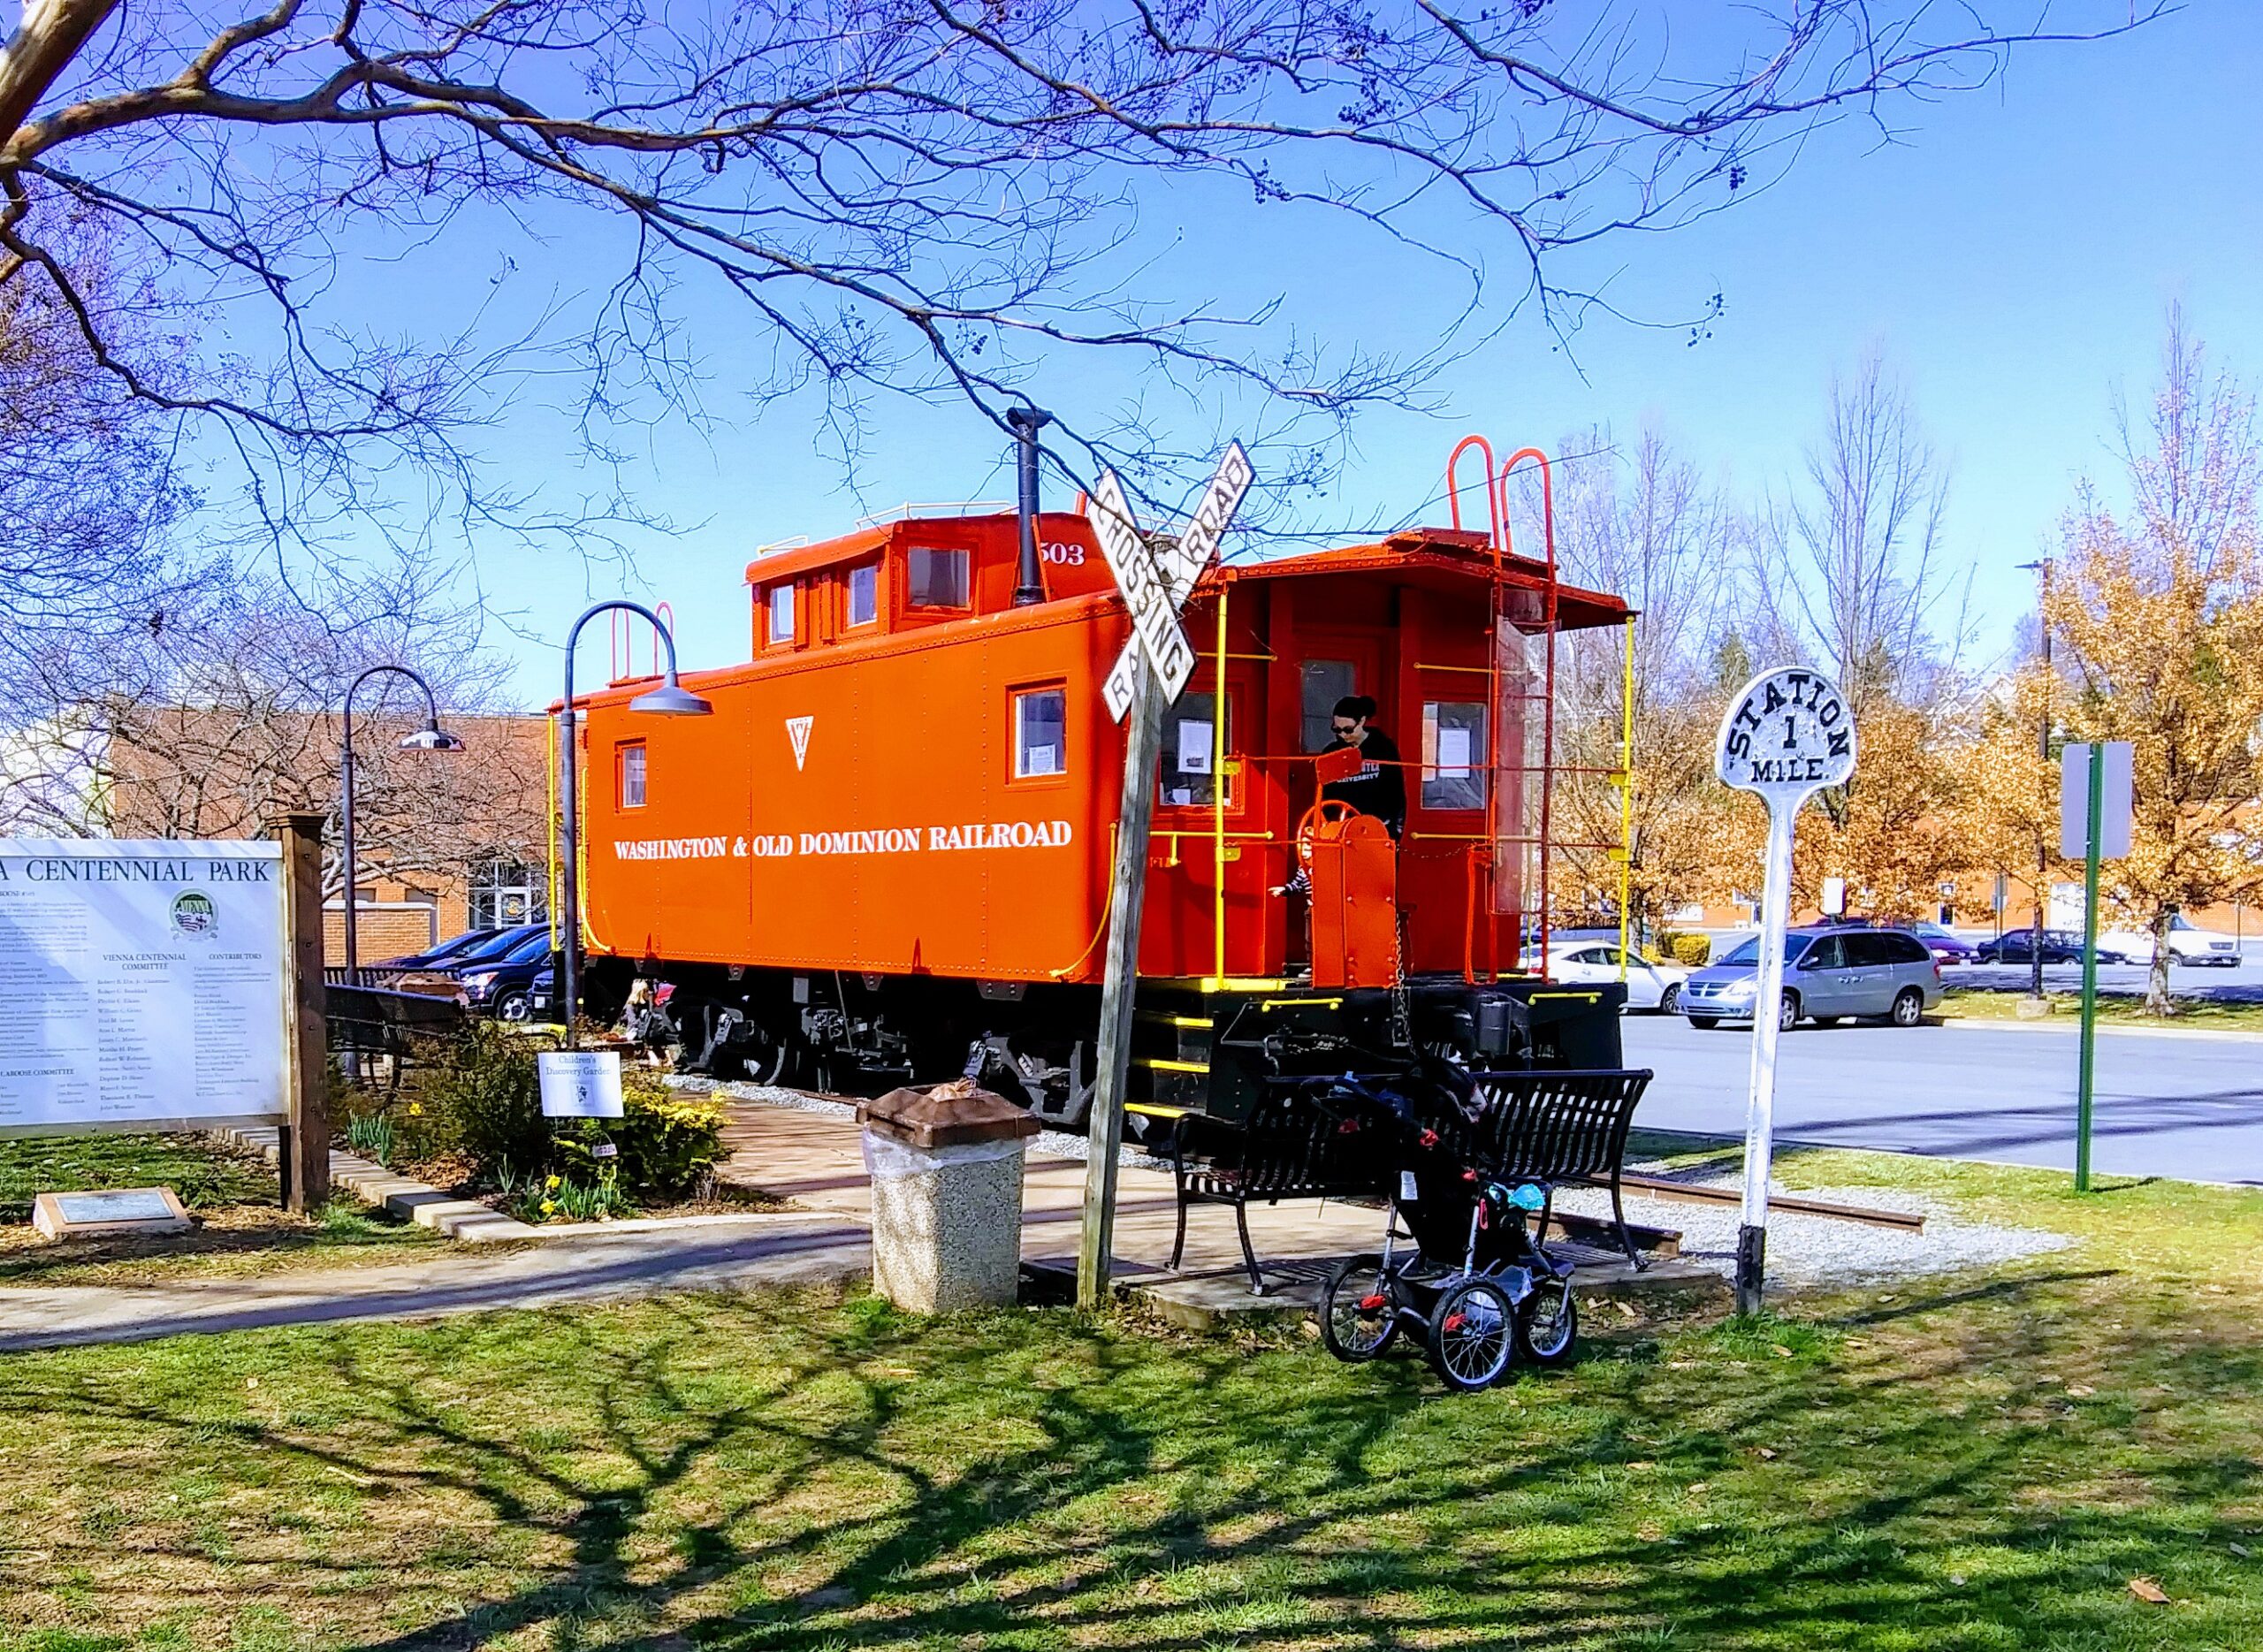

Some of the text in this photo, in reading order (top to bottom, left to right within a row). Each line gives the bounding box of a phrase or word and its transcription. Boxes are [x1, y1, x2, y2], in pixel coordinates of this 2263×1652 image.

[1187, 455, 1244, 567] ROAD
[1040, 542, 1085, 566] 503
[1097, 488, 1183, 681] CROSSING
[1727, 674, 1850, 759] STATION
[1783, 716, 1797, 749] 1
[613, 820, 1072, 860] WASHINGTON & OLD DOMINION RAILROAD
[26, 859, 194, 882] CENTENNIAL
[209, 861, 270, 882] PARK
[179, 900, 210, 913] VIENNA
[545, 1066, 582, 1077] Discovery
[558, 1054, 597, 1064] Children's
